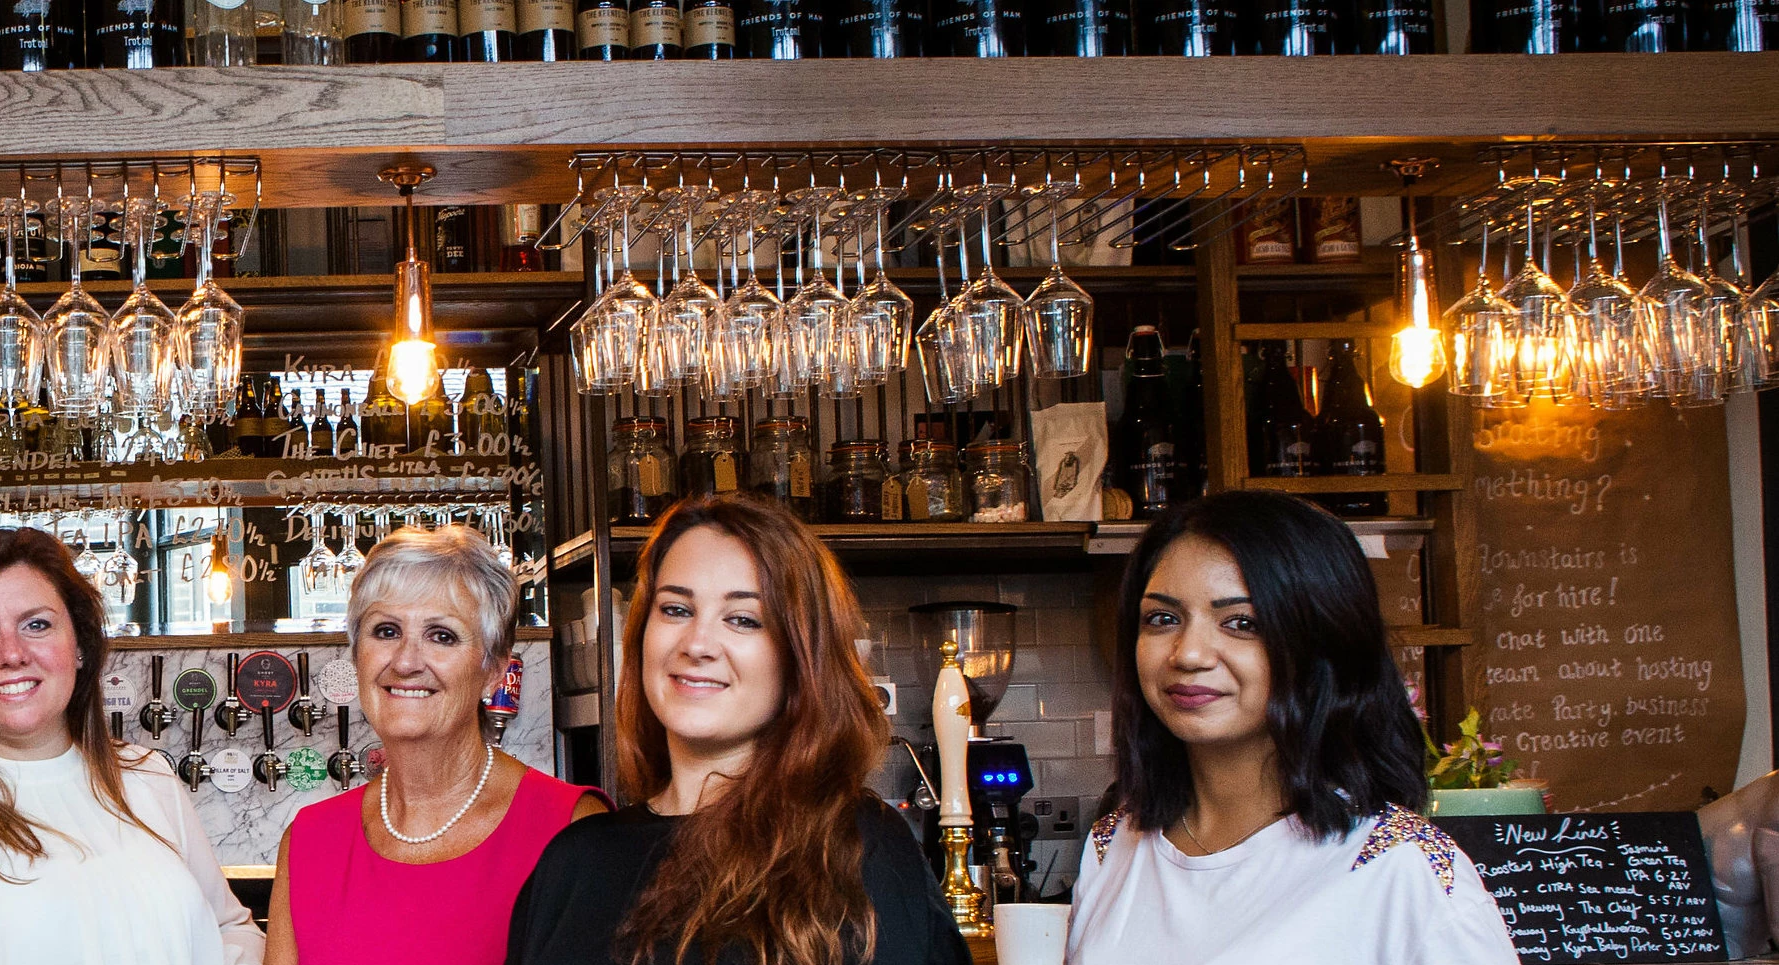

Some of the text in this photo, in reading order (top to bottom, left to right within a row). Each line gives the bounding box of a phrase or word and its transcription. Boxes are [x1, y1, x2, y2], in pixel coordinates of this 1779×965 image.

[740, 13, 782, 27] FRIENDS
[840, 12, 882, 26] FRIENDS
[1046, 11, 1090, 24] FRIENDS
[1155, 10, 1200, 23] FRIENDS
[1265, 9, 1311, 20] FRIENDS
[1368, 8, 1414, 19] FRIENDS
[38, 24, 51, 32] OF
[96, 22, 155, 36] FRIENDS OF
[284, 353, 356, 384] KYRA
[272, 425, 320, 461] THE
[335, 427, 406, 462] CHIEF
[387, 460, 441, 476] CITRA
[22, 485, 79, 511] LIME
[104, 520, 153, 549] IPA
[1619, 541, 1638, 565] is
[1511, 583, 1550, 618] for
[1555, 576, 1620, 611] hire!
[1561, 622, 1610, 646] with
[1558, 658, 1622, 680] about
[1636, 656, 1712, 692] hosting
[253, 680, 277, 688] KYRA
[118, 697, 131, 706] TEA
[1626, 695, 1710, 717] business
[1622, 724, 1686, 746] event
[1504, 817, 1610, 845] New Lines
[1616, 840, 1669, 856] Jasmine
[1540, 855, 1578, 875] High
[1575, 854, 1603, 869] Tea
[1628, 855, 1688, 868] Green Tea
[1624, 869, 1651, 881] IPA
[1536, 882, 1644, 896] CITRA Sea mead
[1668, 882, 1691, 891] ABV
[1685, 897, 1706, 906] ABV
[1577, 900, 1604, 915] The
[1608, 900, 1643, 920] Chief
[1682, 916, 1706, 925] ABV
[1693, 928, 1714, 938] ABV
[1562, 936, 1663, 959] Kyra Baby Porter
[1698, 943, 1721, 952] ABV
